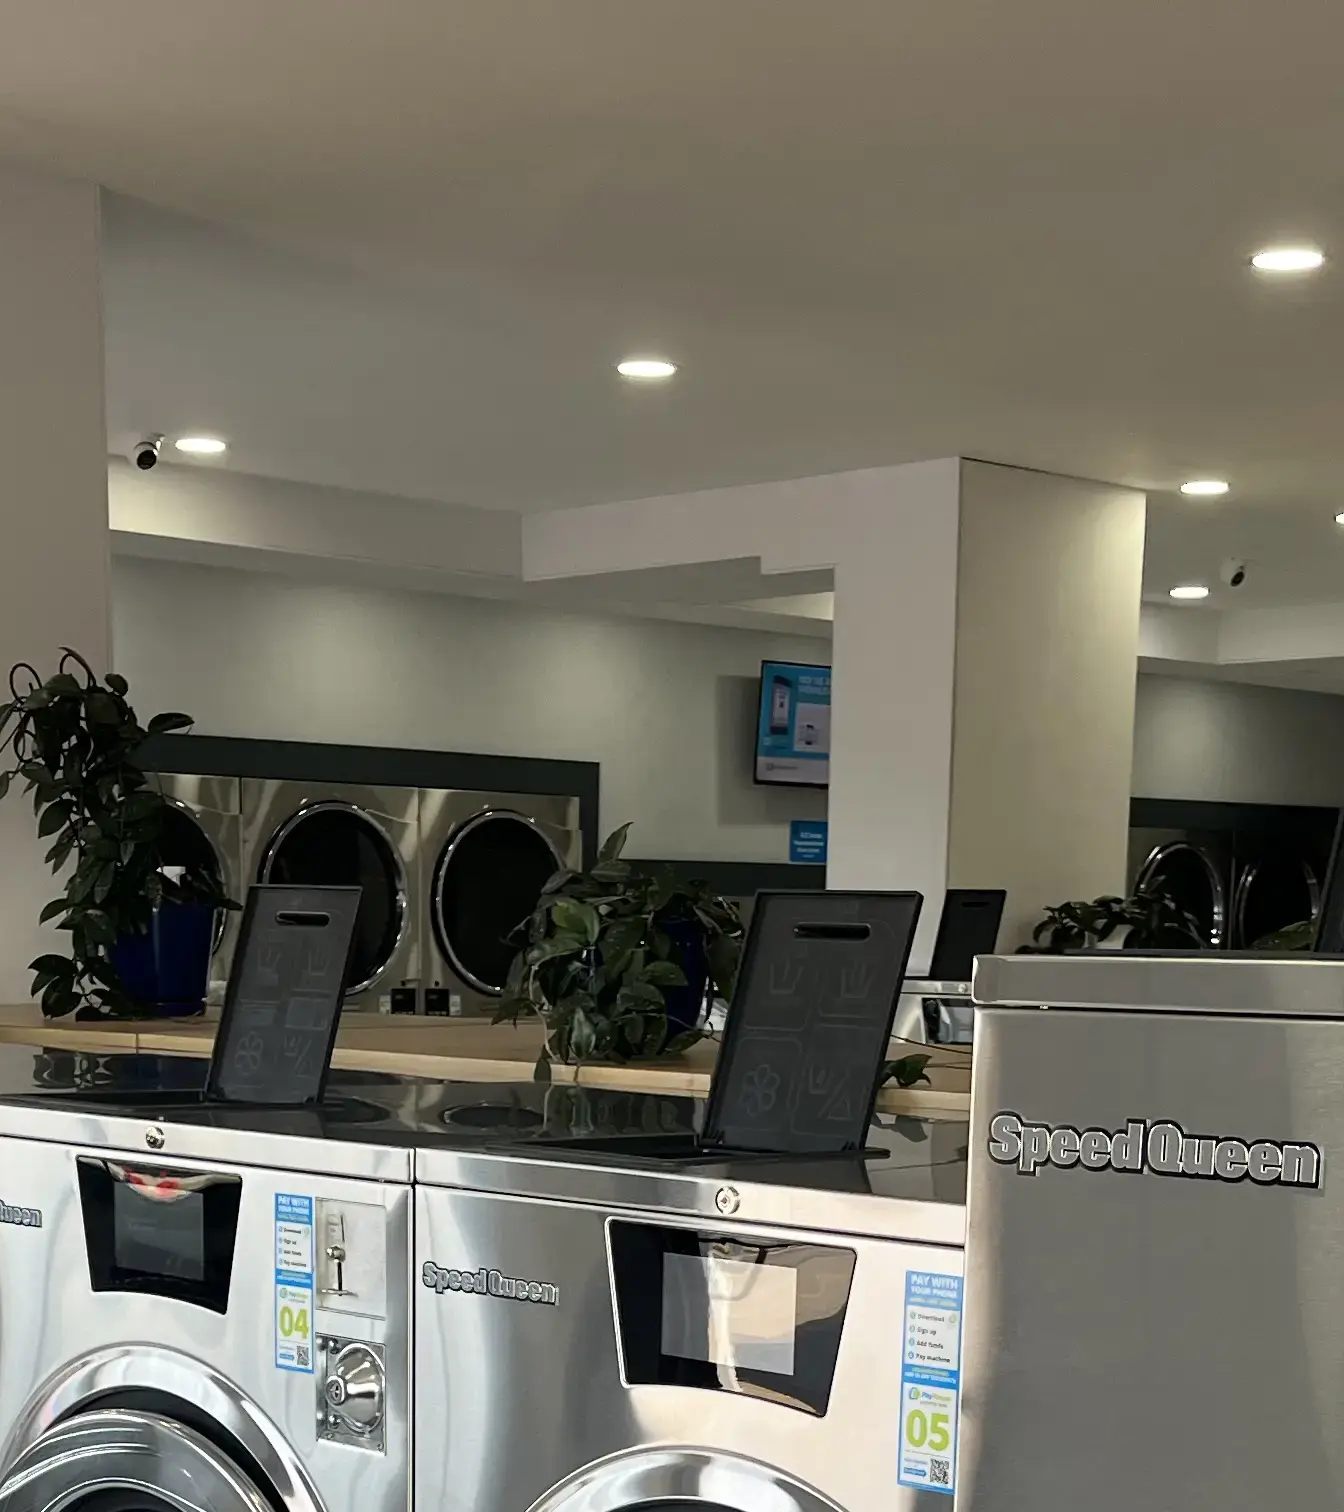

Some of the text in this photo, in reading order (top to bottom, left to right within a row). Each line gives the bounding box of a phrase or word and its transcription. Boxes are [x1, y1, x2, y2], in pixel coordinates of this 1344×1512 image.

[989, 1112, 1320, 1187] Speed Queen
[422, 1261, 559, 1305] Speed Queen
[910, 1274, 958, 1289] PAY WITH
[279, 1306, 309, 1340] 04
[905, 1409, 949, 1451] 05
